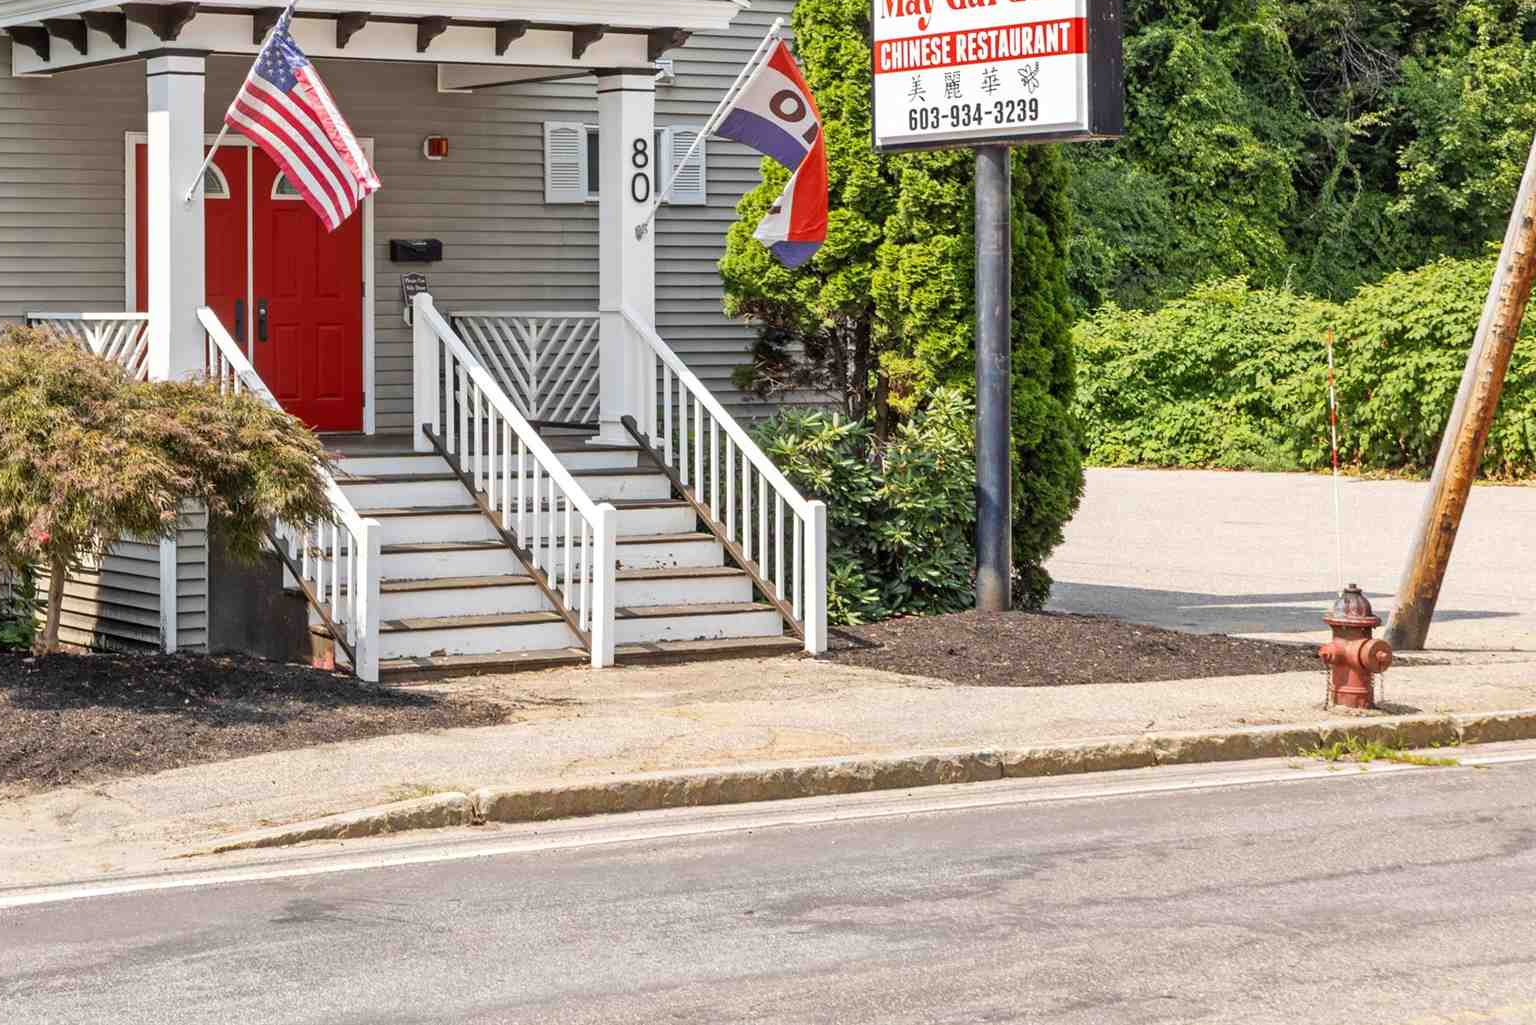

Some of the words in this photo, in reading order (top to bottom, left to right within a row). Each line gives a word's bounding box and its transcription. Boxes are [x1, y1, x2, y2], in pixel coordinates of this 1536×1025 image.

[880, 35, 951, 71] CHINESE
[955, 22, 1071, 62] RESTAURANT
[909, 97, 1040, 131] 603-934-3239
[631, 137, 650, 203] 80
